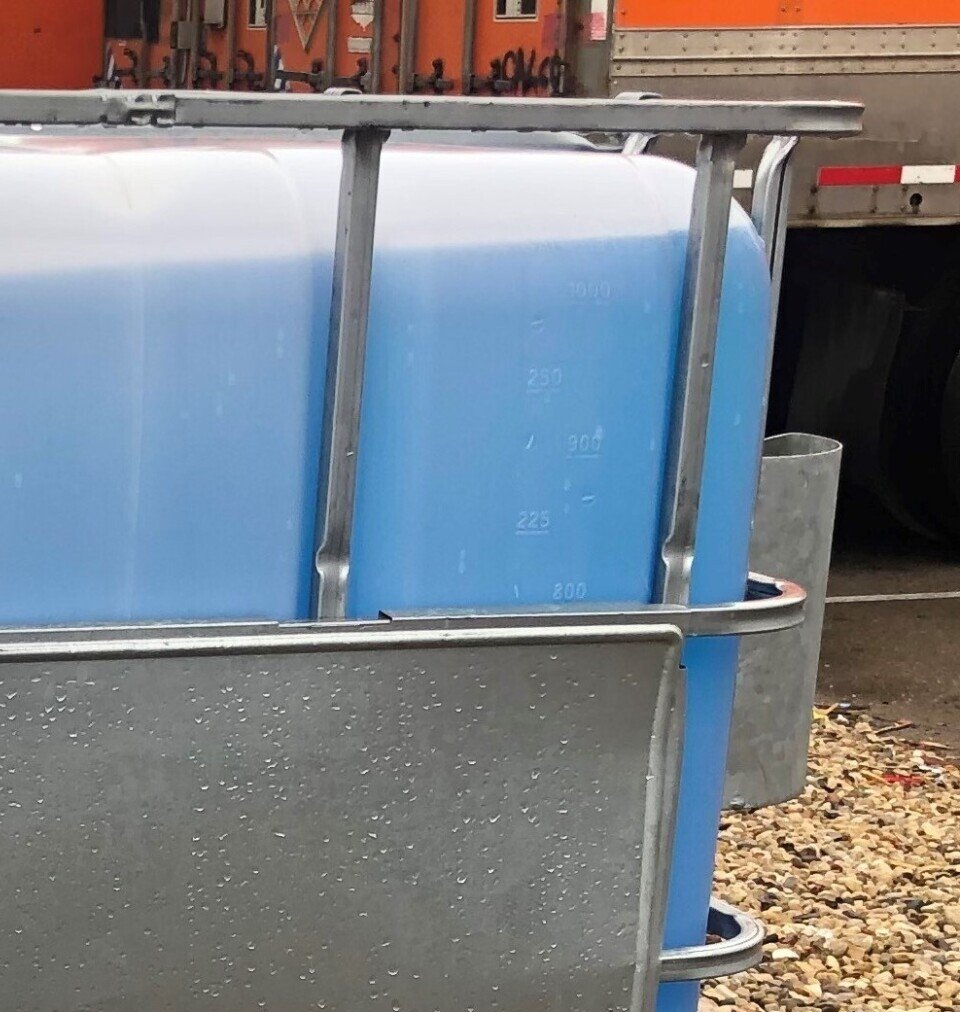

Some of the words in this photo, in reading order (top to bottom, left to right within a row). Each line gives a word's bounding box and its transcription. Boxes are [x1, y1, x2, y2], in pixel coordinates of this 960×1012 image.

[527, 368, 562, 386] 250
[517, 510, 551, 529] 225
[553, 583, 587, 600] 800
